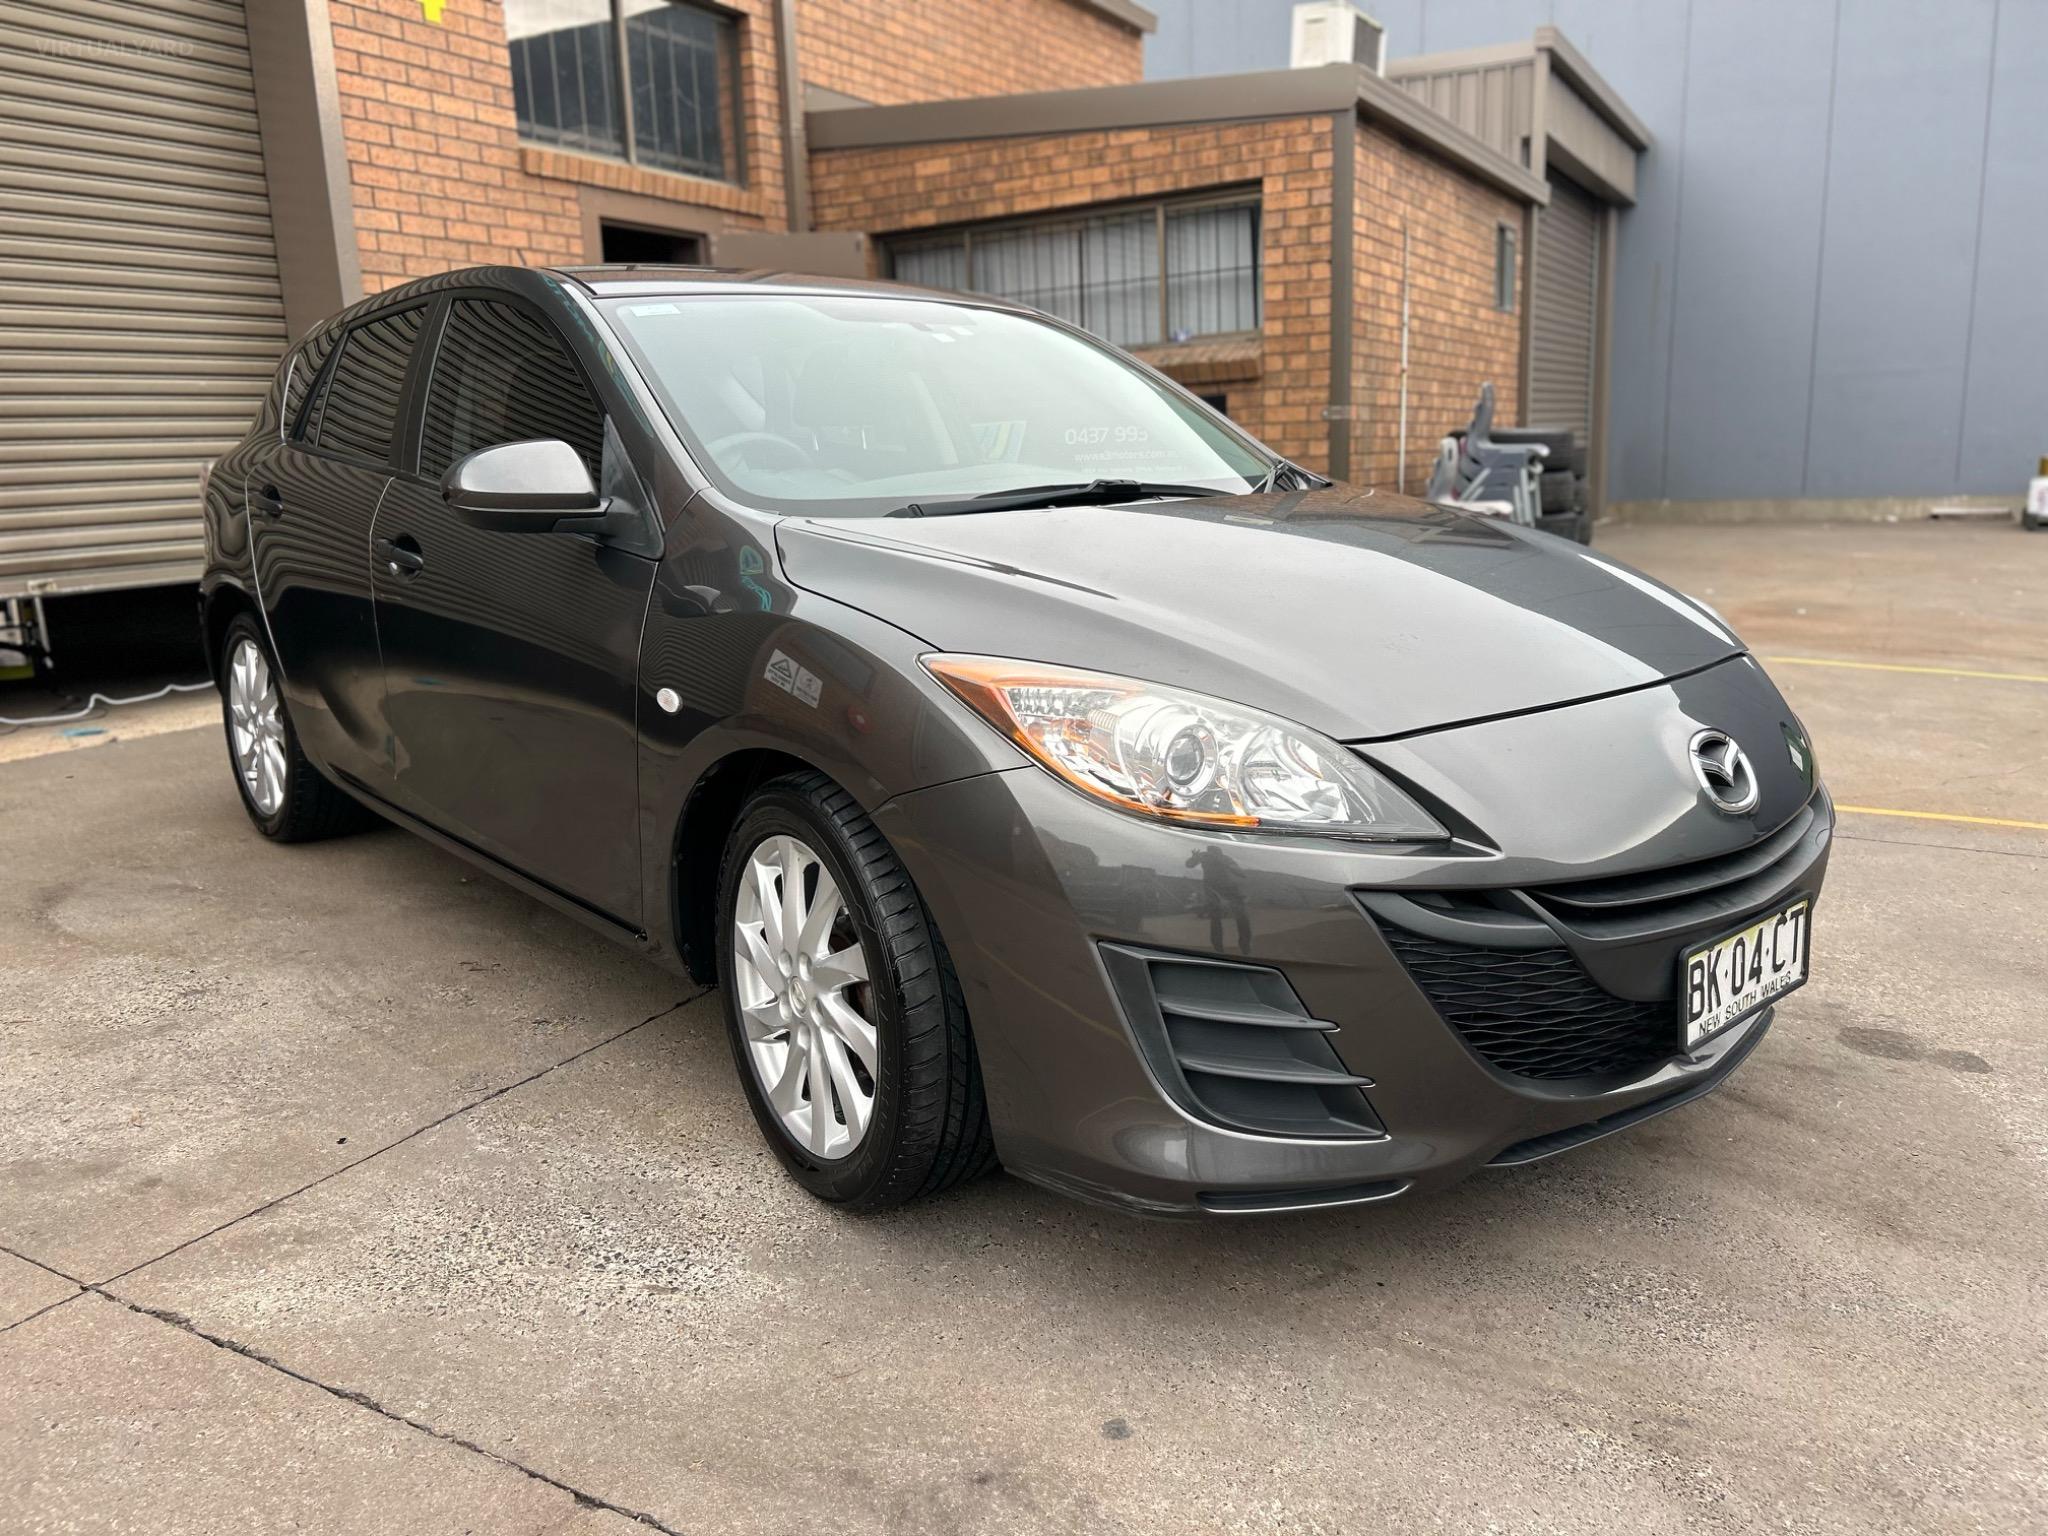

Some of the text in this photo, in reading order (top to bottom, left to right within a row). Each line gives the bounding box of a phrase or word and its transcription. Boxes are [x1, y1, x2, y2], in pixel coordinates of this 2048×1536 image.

[1064, 427, 1109, 445] 0437
[1699, 970, 1792, 1034] NEW SOUTH WALES
